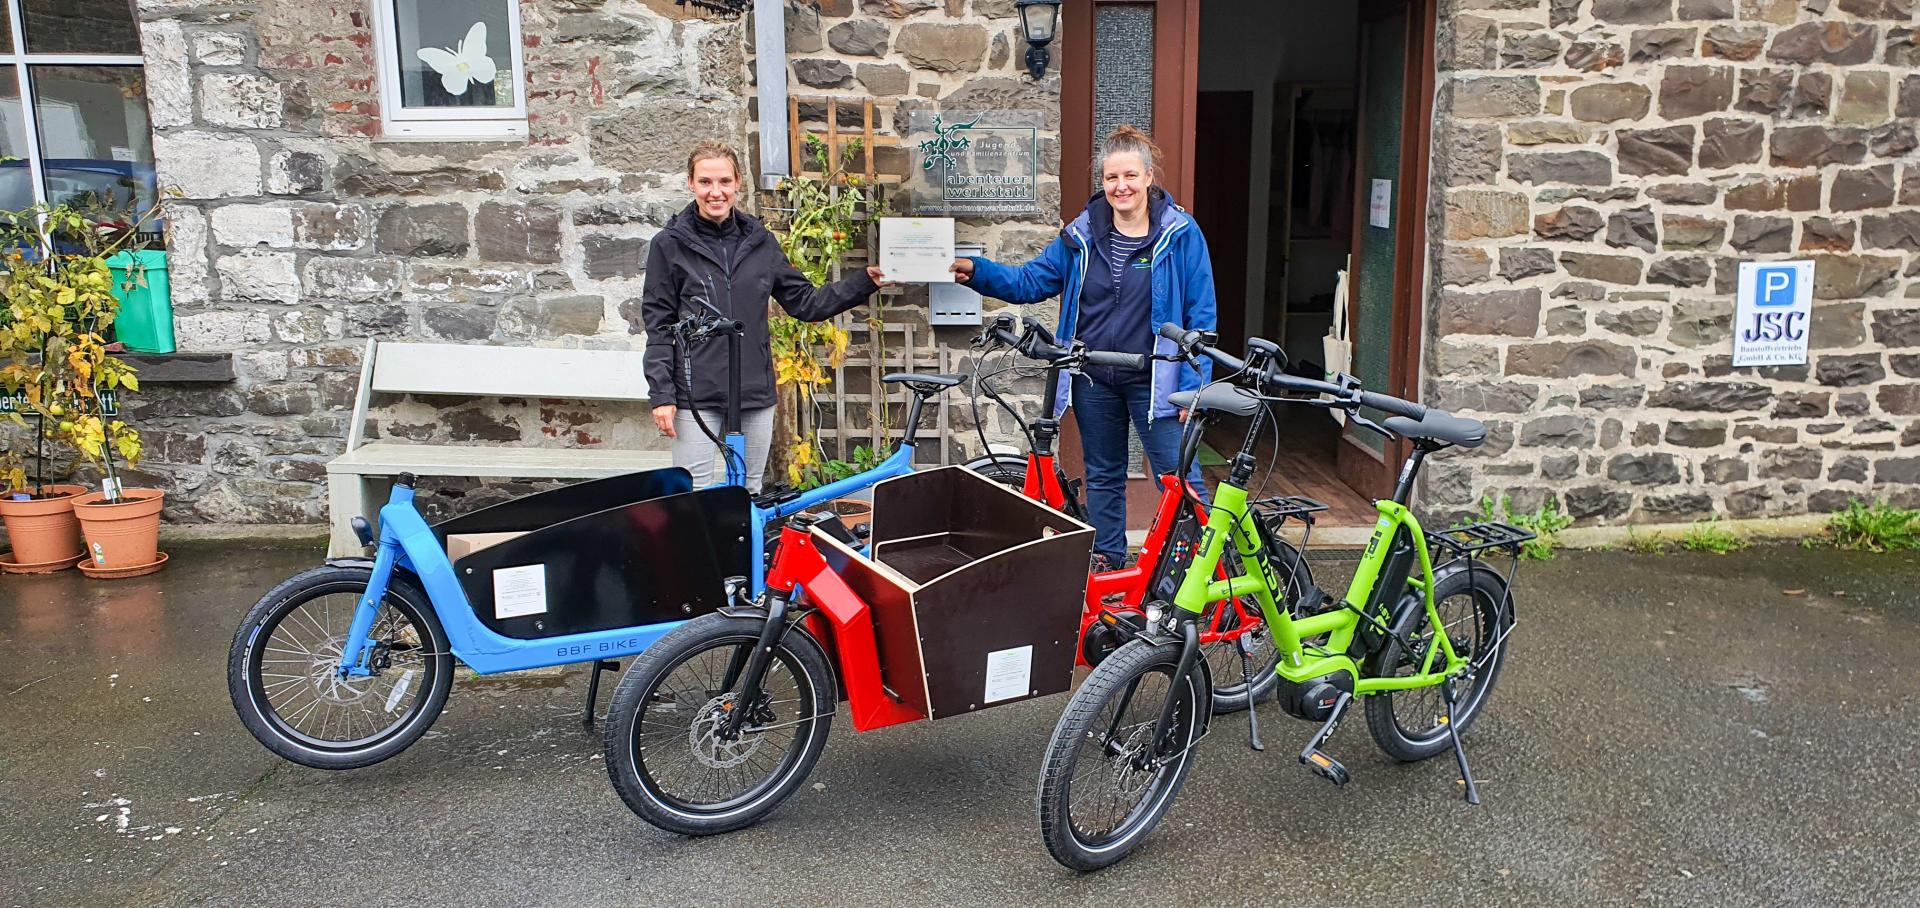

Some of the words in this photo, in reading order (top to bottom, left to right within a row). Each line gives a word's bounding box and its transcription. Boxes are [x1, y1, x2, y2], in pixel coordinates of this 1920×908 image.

[947, 173, 1028, 185] abenteuer
[948, 186, 1028, 198] werkstatt
[1764, 271, 1790, 303] P
[1742, 311, 1805, 343] JSC
[1739, 354, 1764, 362] GmbH
[557, 645, 592, 657] BBF
[599, 638, 638, 652] BIKE
